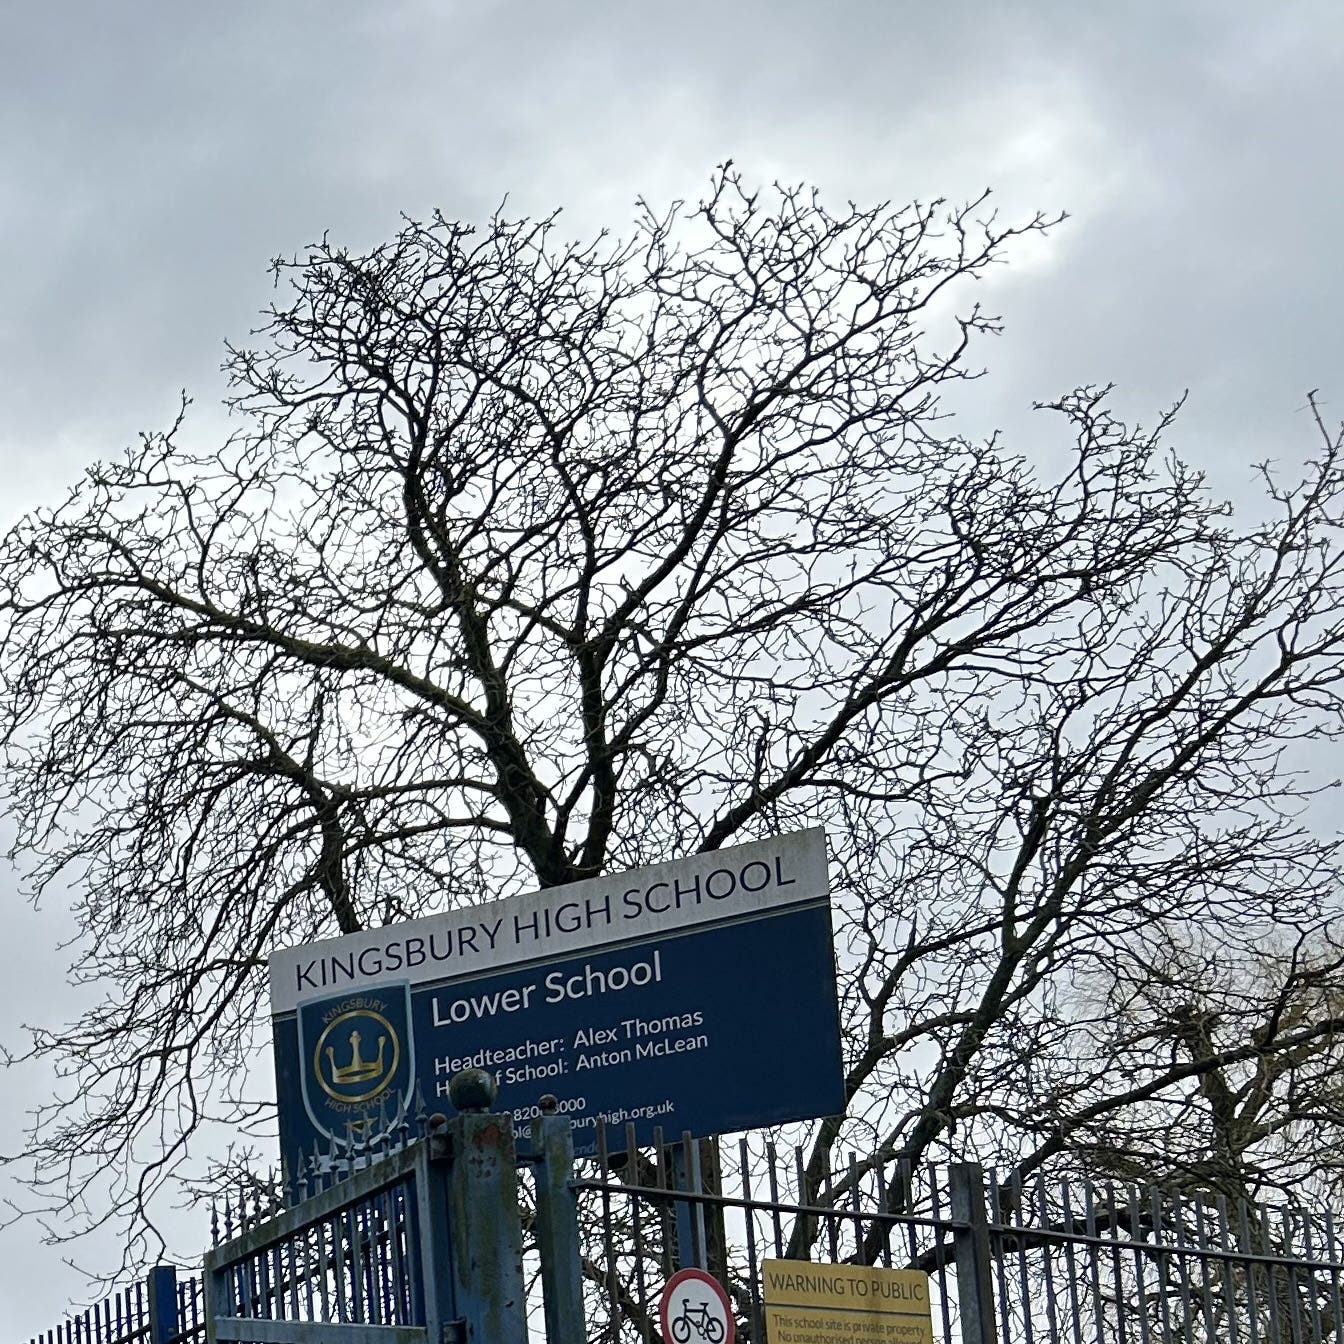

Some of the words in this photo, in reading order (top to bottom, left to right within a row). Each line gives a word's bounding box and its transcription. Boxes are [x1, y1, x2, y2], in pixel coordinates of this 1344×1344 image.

[295, 918, 503, 992] KINGSBURY
[514, 899, 612, 945] HIGH
[622, 855, 796, 920] SCHOOL
[431, 983, 537, 1027] Lower
[545, 951, 662, 1003] School
[322, 997, 388, 1024] KINGSBURY
[434, 1038, 565, 1076] Headteacher:
[573, 1027, 618, 1049] Alex
[621, 1010, 704, 1039] Thomas
[505, 1059, 569, 1085] School:
[575, 1049, 631, 1071] Anton
[636, 1033, 708, 1061] McLean
[324, 1097, 352, 1113] HIGH
[353, 1086, 396, 1113] SCHOOL
[513, 1105, 543, 1122] 820
[769, 1272, 844, 1295] WARNING
[847, 1279, 868, 1297] TO
[871, 1280, 924, 1301] PUBLIC
[773, 1313, 792, 1327] This
[794, 1316, 823, 1329] school
[825, 1318, 842, 1330] site
[844, 1320, 852, 1331] is
[853, 1321, 885, 1334] private
[778, 1330, 792, 1343] No
